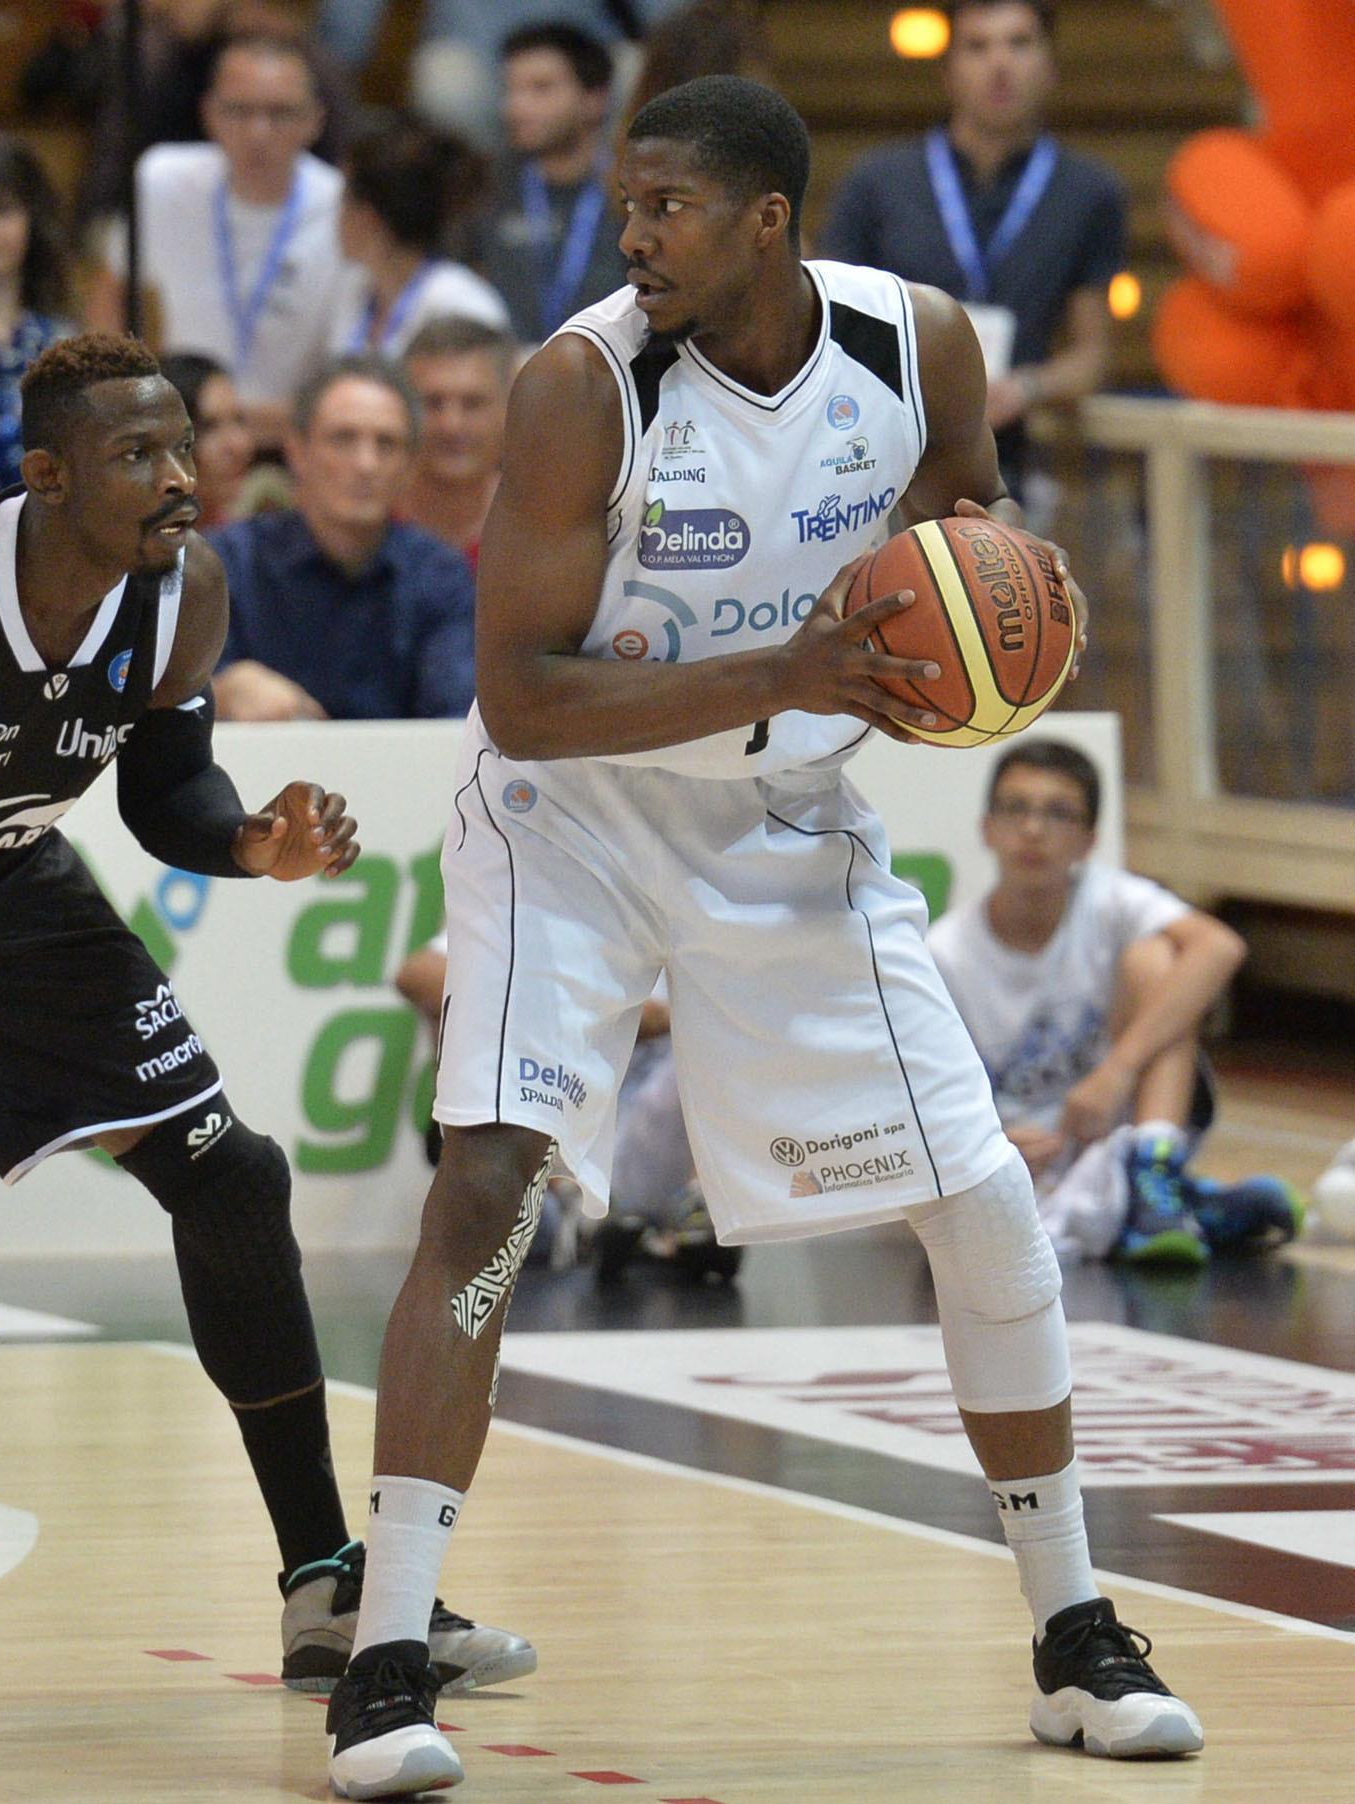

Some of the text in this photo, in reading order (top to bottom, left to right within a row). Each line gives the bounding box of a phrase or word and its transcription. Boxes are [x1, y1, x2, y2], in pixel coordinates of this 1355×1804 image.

[820, 456, 853, 468] AQUILA
[836, 459, 877, 475] BASKET
[791, 487, 895, 543] TRENTINO
[687, 554, 702, 562] VAL
[703, 554, 711, 562] DI
[713, 553, 734, 562] NON
[957, 527, 1025, 651] molten
[805, 1123, 880, 1154] Dorigoni
[883, 1122, 906, 1135] spa
[821, 1150, 911, 1183] PHOENIX
[824, 1168, 914, 1193] Informatica Bancaria
